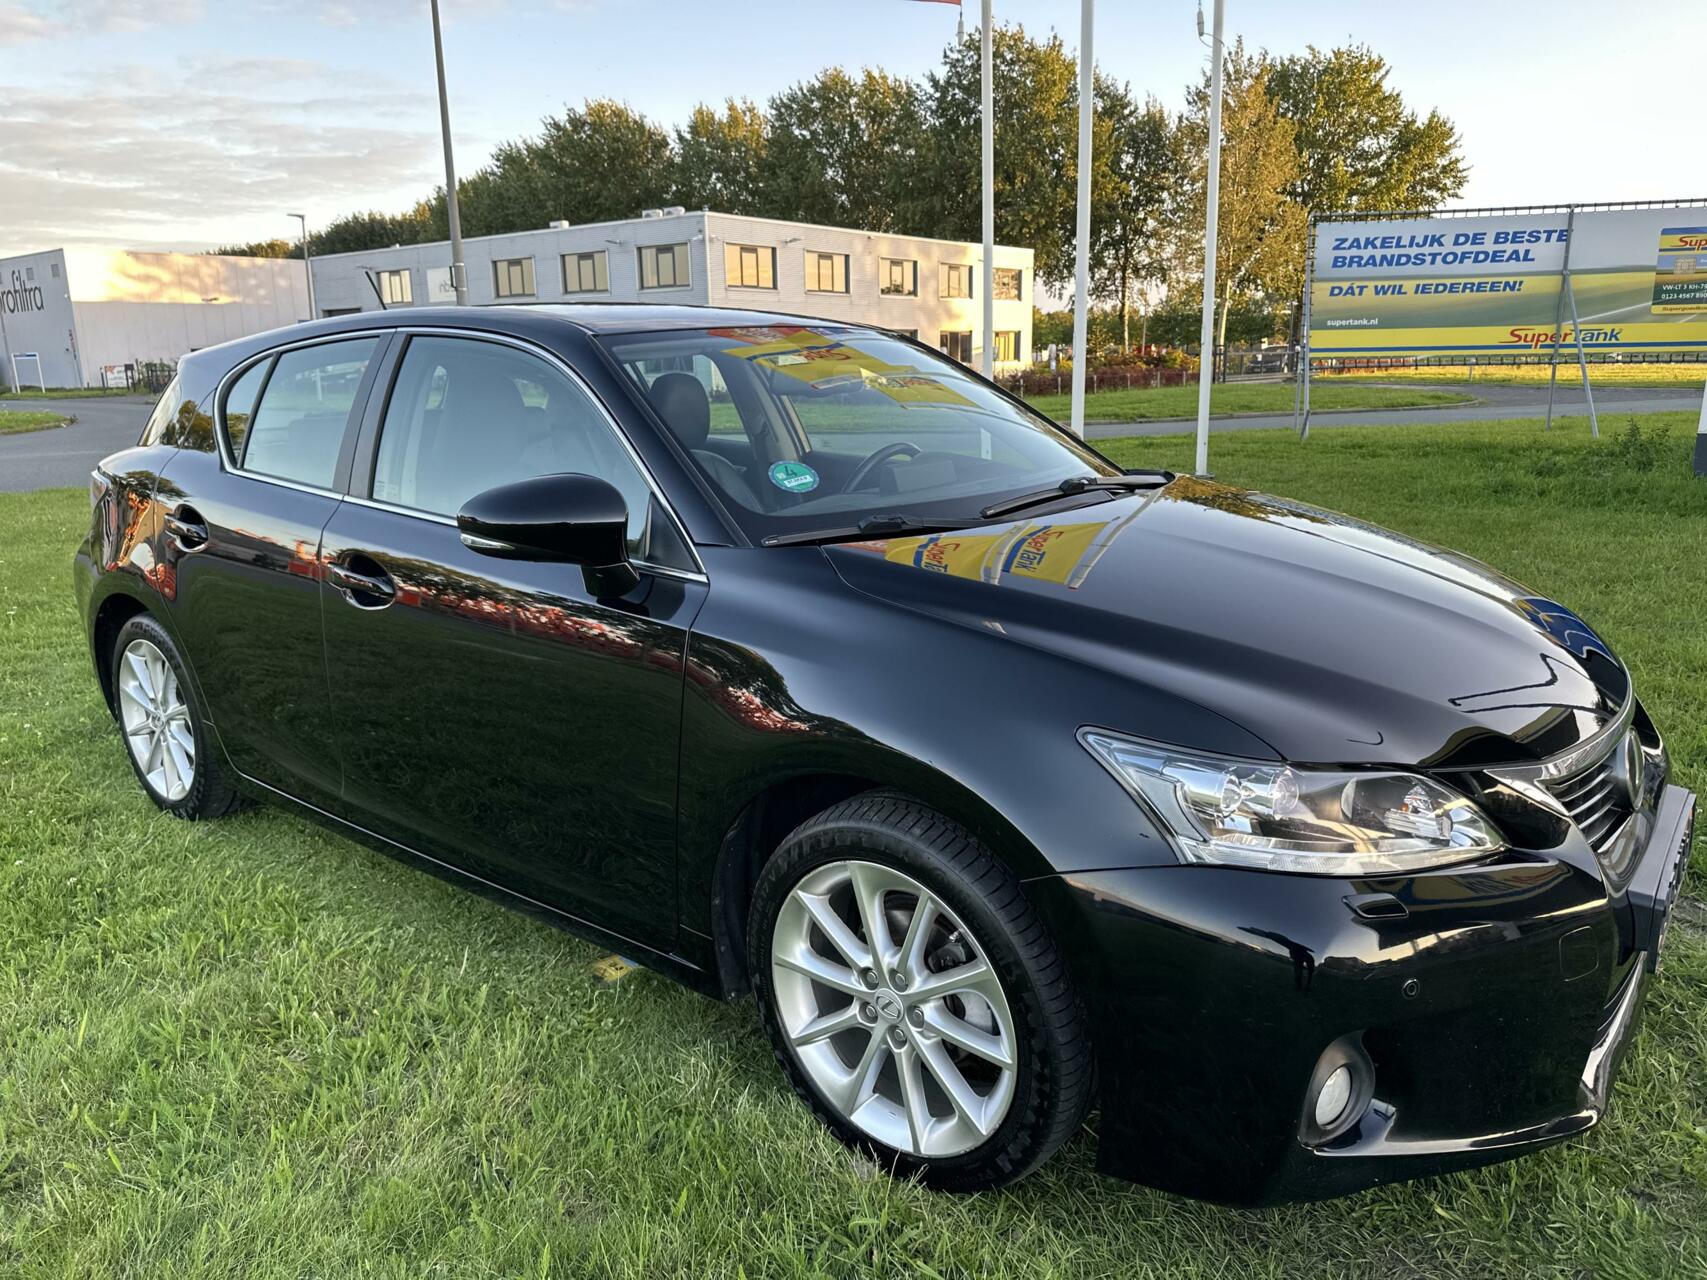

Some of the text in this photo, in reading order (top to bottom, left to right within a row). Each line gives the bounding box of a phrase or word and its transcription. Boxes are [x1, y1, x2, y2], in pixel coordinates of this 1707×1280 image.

[1332, 228, 1573, 251] ZAKELIJK DE BESTE
[1331, 248, 1535, 269] BRANDSTOFDEAL
[0, 269, 44, 314] rofiltra
[1329, 280, 1524, 297] DÁT WIL IEDEREEN!
[1327, 317, 1379, 327] supertank.nl
